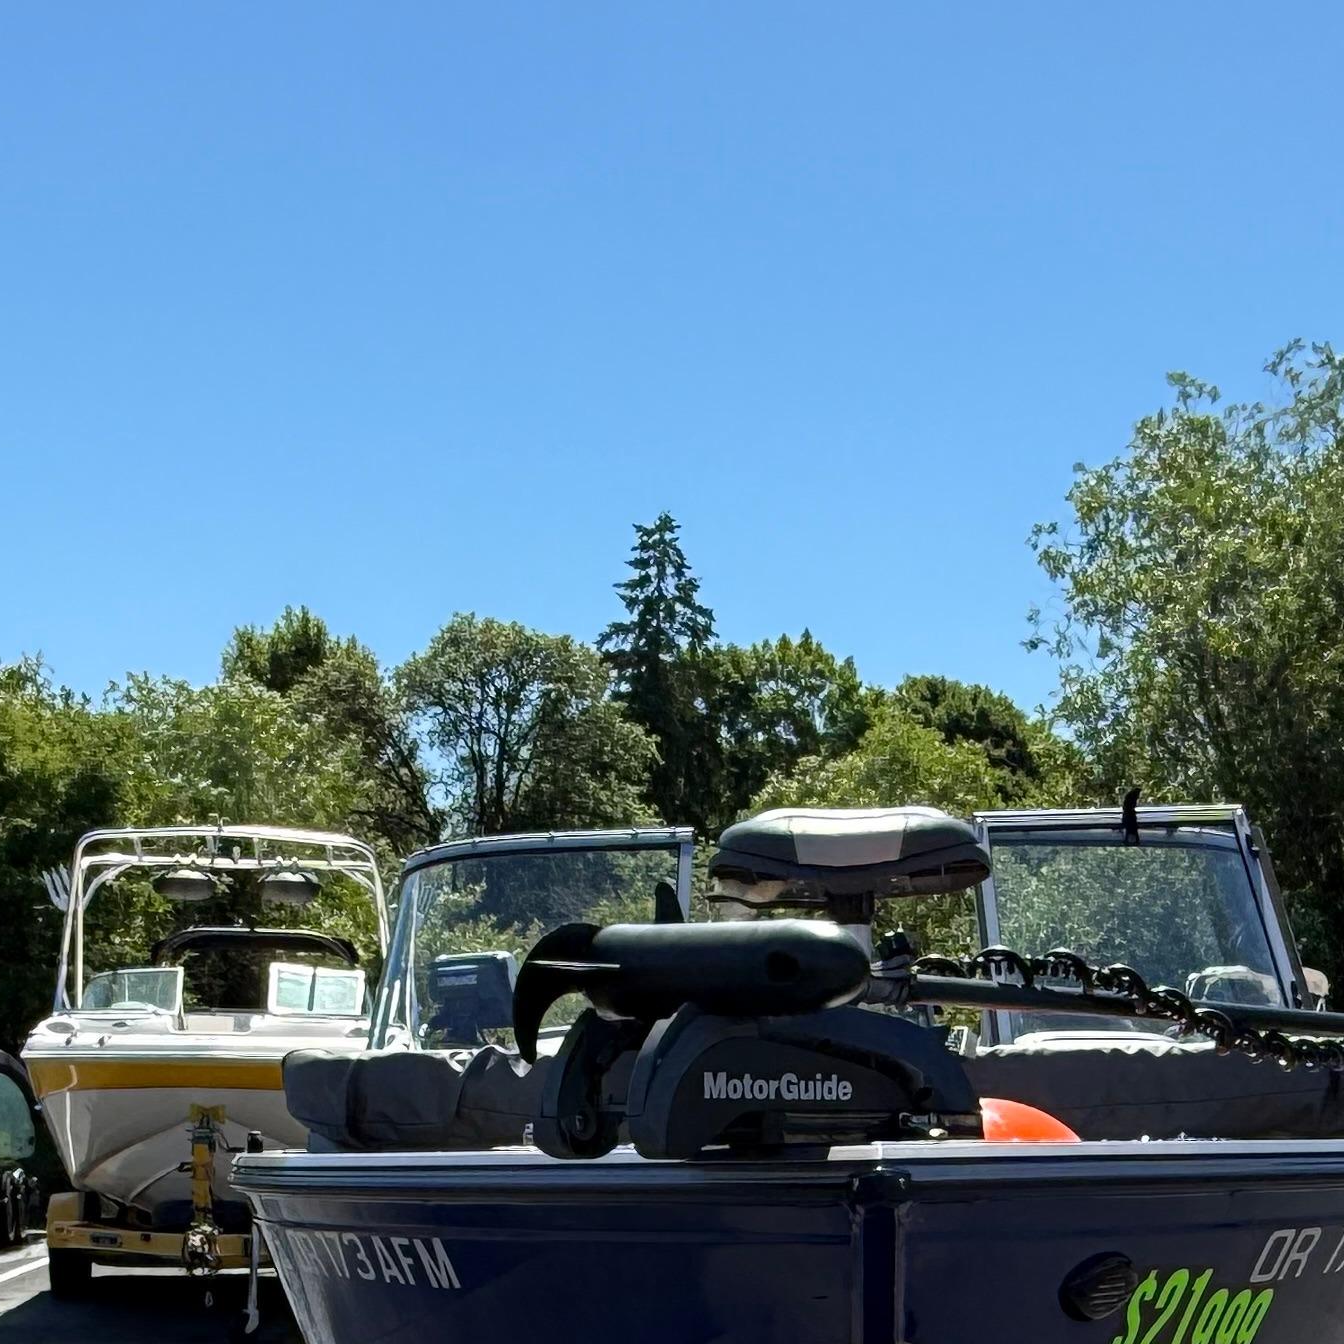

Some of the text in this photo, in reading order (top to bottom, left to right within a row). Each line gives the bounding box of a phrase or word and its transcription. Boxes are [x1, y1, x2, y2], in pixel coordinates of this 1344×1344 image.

[703, 1071, 853, 1101] MotorGuide
[314, 1231, 377, 1281] 173
[370, 1235, 462, 1289] AFM
[1250, 1227, 1322, 1284] OR
